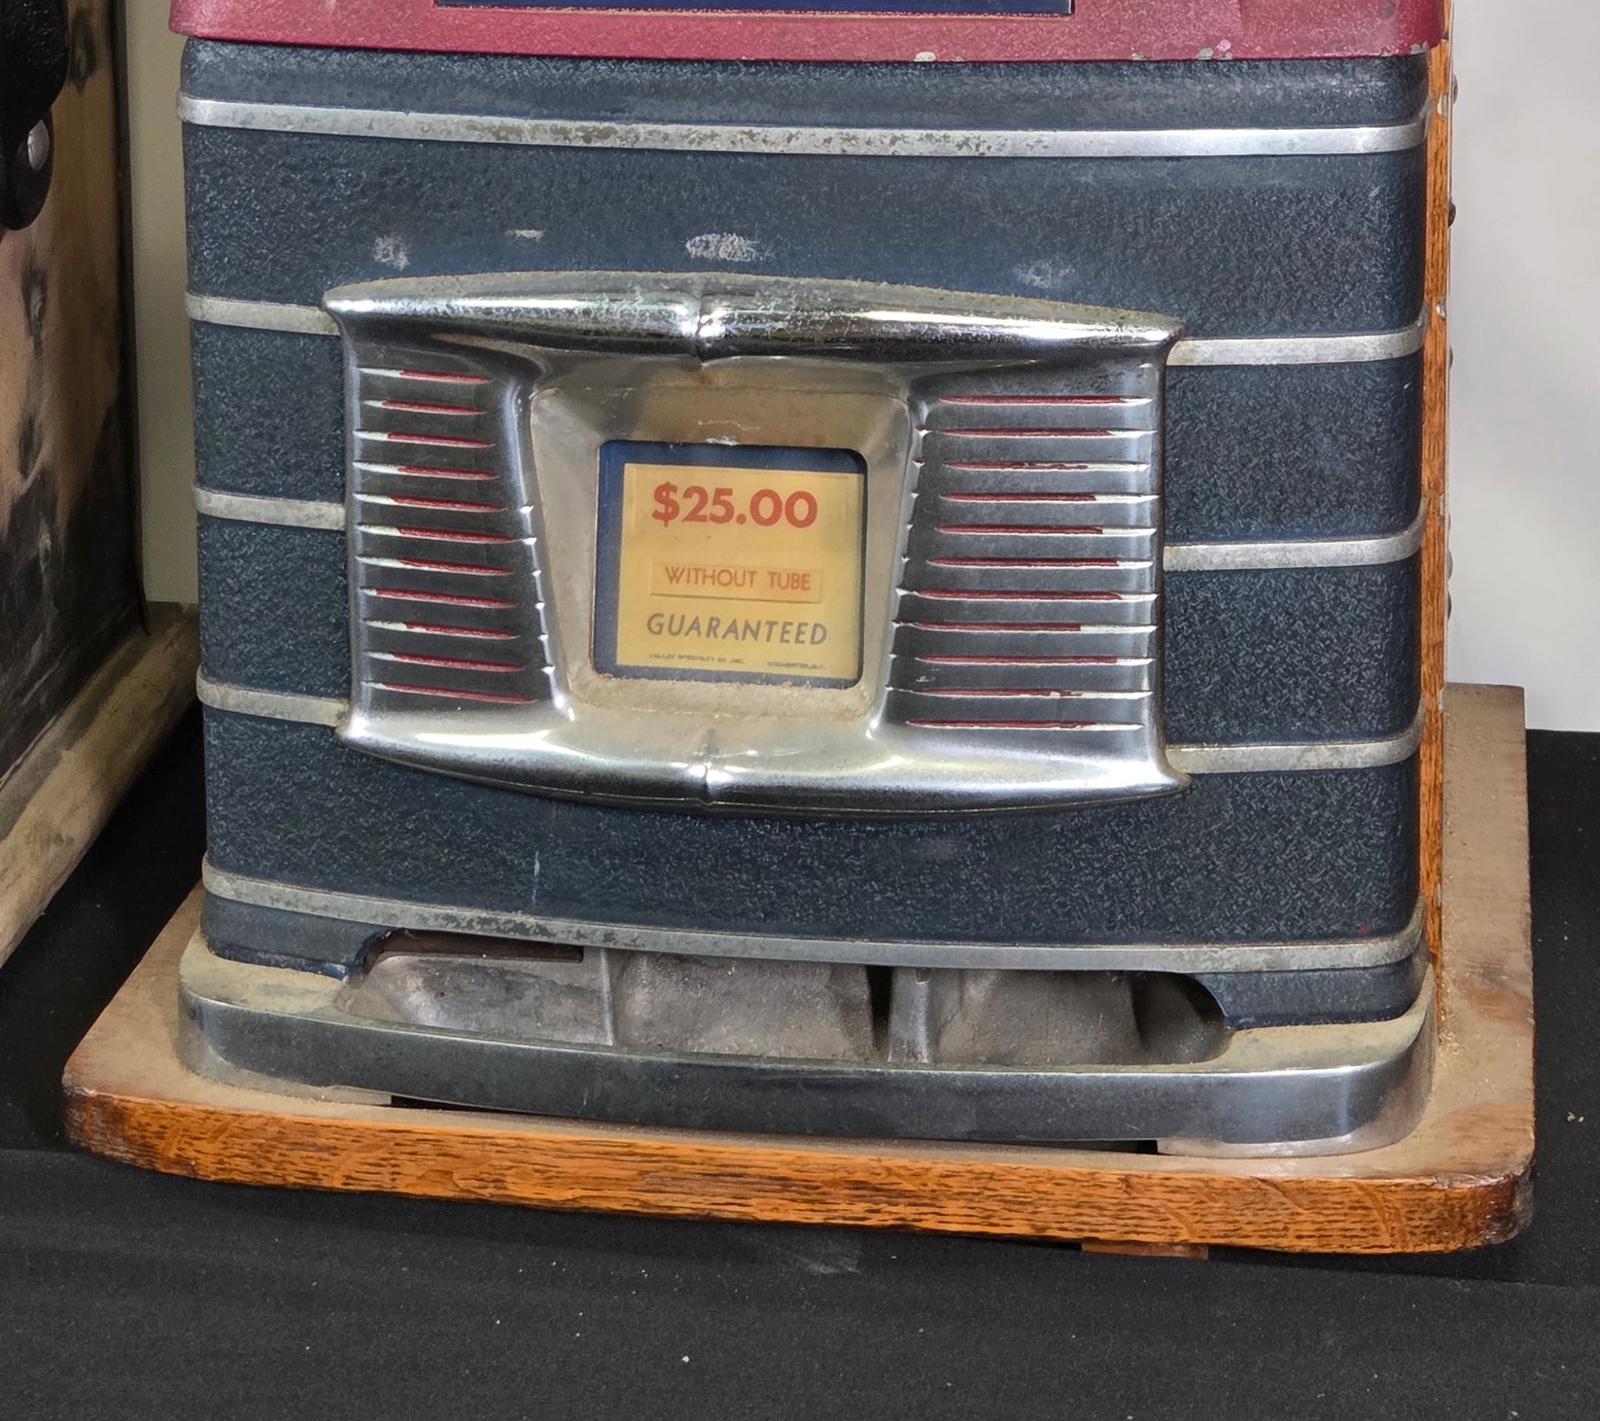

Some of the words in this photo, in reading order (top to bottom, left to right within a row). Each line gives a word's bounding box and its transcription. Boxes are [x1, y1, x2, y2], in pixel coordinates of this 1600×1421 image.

[652, 481, 819, 529] $25.00
[665, 565, 758, 588] WITHOUT
[767, 570, 811, 591] TUBE
[646, 612, 828, 646] GUARANTEED
